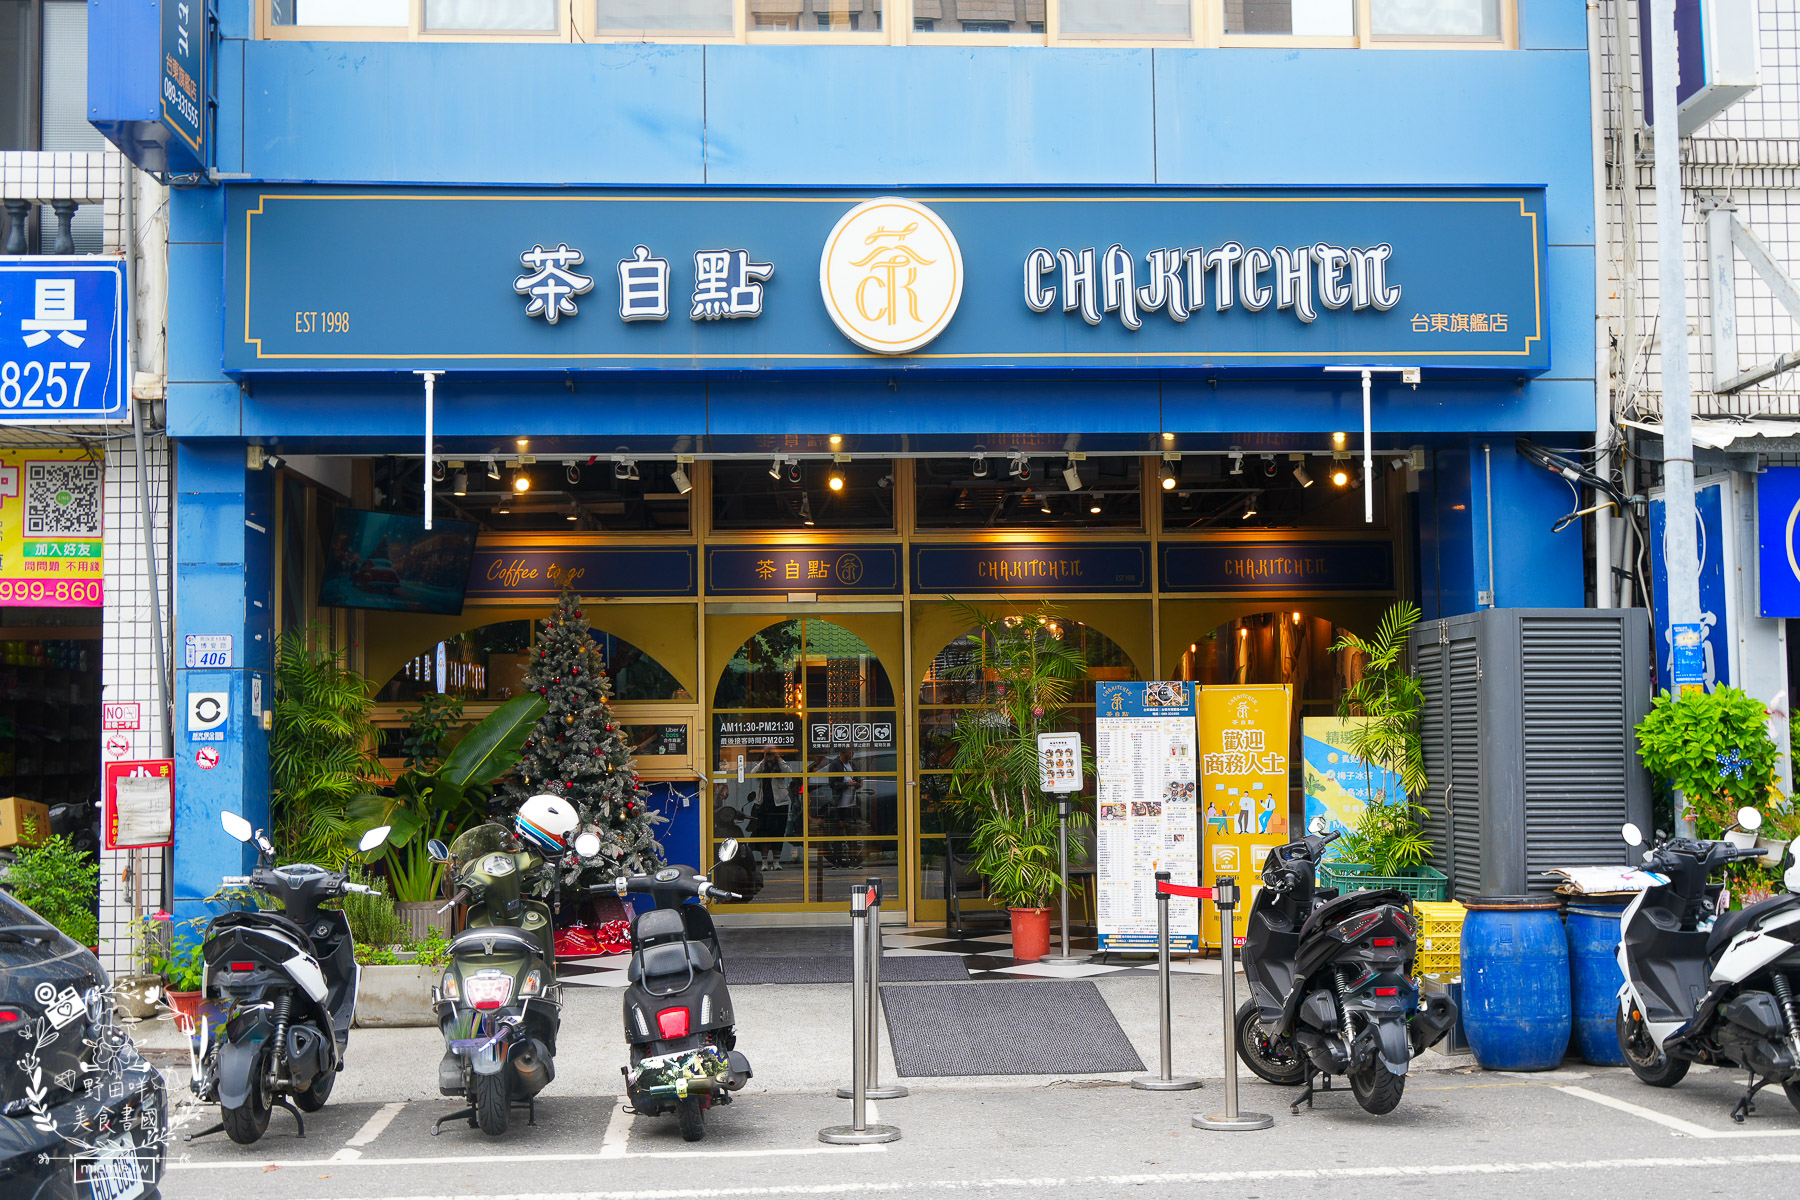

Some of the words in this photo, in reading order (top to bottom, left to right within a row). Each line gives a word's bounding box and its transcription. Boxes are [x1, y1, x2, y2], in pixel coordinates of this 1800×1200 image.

[164, 77, 199, 129] 089-331555
[512, 242, 775, 325] 茶自點
[1023, 241, 1402, 331] CHAKITCHEN
[295, 311, 318, 333] EST
[321, 311, 350, 333] 1998
[1410, 312, 1509, 333] 台東旗艦店
[0, 361, 91, 409] 8257
[35, 543, 91, 557] 加入好友
[24, 561, 60, 572] 問問題
[66, 561, 100, 572] 不用錢
[486, 558, 539, 587] Coffee
[546, 562, 561, 579] to
[566, 567, 585, 586] go
[755, 559, 831, 581] 茶自點
[978, 558, 1084, 582] CHAKITCHEN
[1224, 557, 1328, 580] CHAKITCHEN
[0, 581, 100, 601] 999-860
[200, 652, 227, 666] 406
[106, 706, 123, 720] NO
[720, 721, 795, 733] AM11:30-PM21:30
[1222, 729, 1265, 752] 歡迎
[1203, 752, 1286, 776] 商務人士
